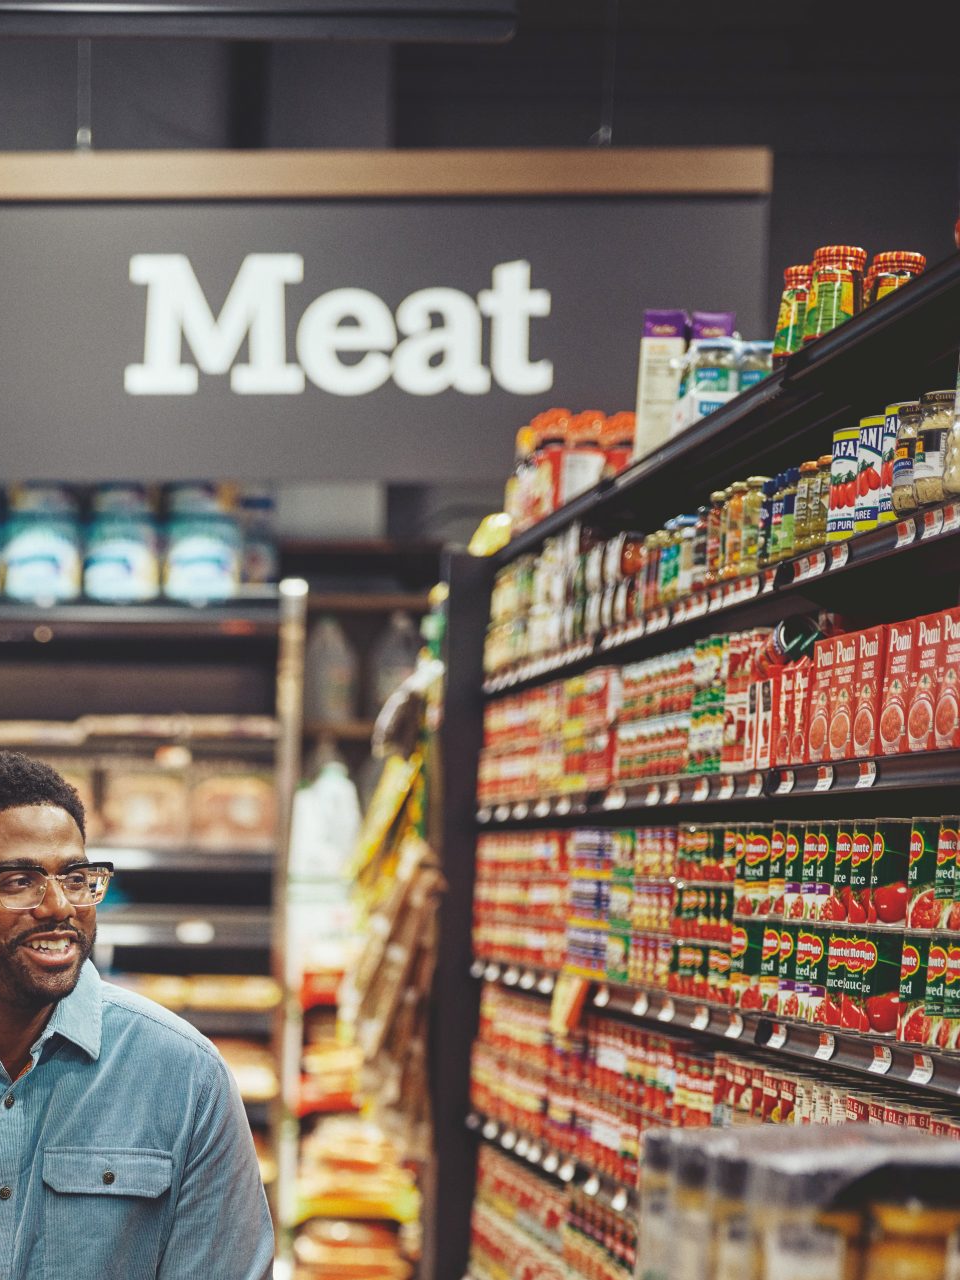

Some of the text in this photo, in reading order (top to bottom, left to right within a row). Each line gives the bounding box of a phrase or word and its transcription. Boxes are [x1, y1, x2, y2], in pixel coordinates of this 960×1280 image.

[123, 253, 554, 396] Meat
[860, 632, 879, 659] Pomì
[890, 626, 913, 653] Pomì
[918, 620, 941, 647] Pomì
[836, 638, 856, 664] Pomì
